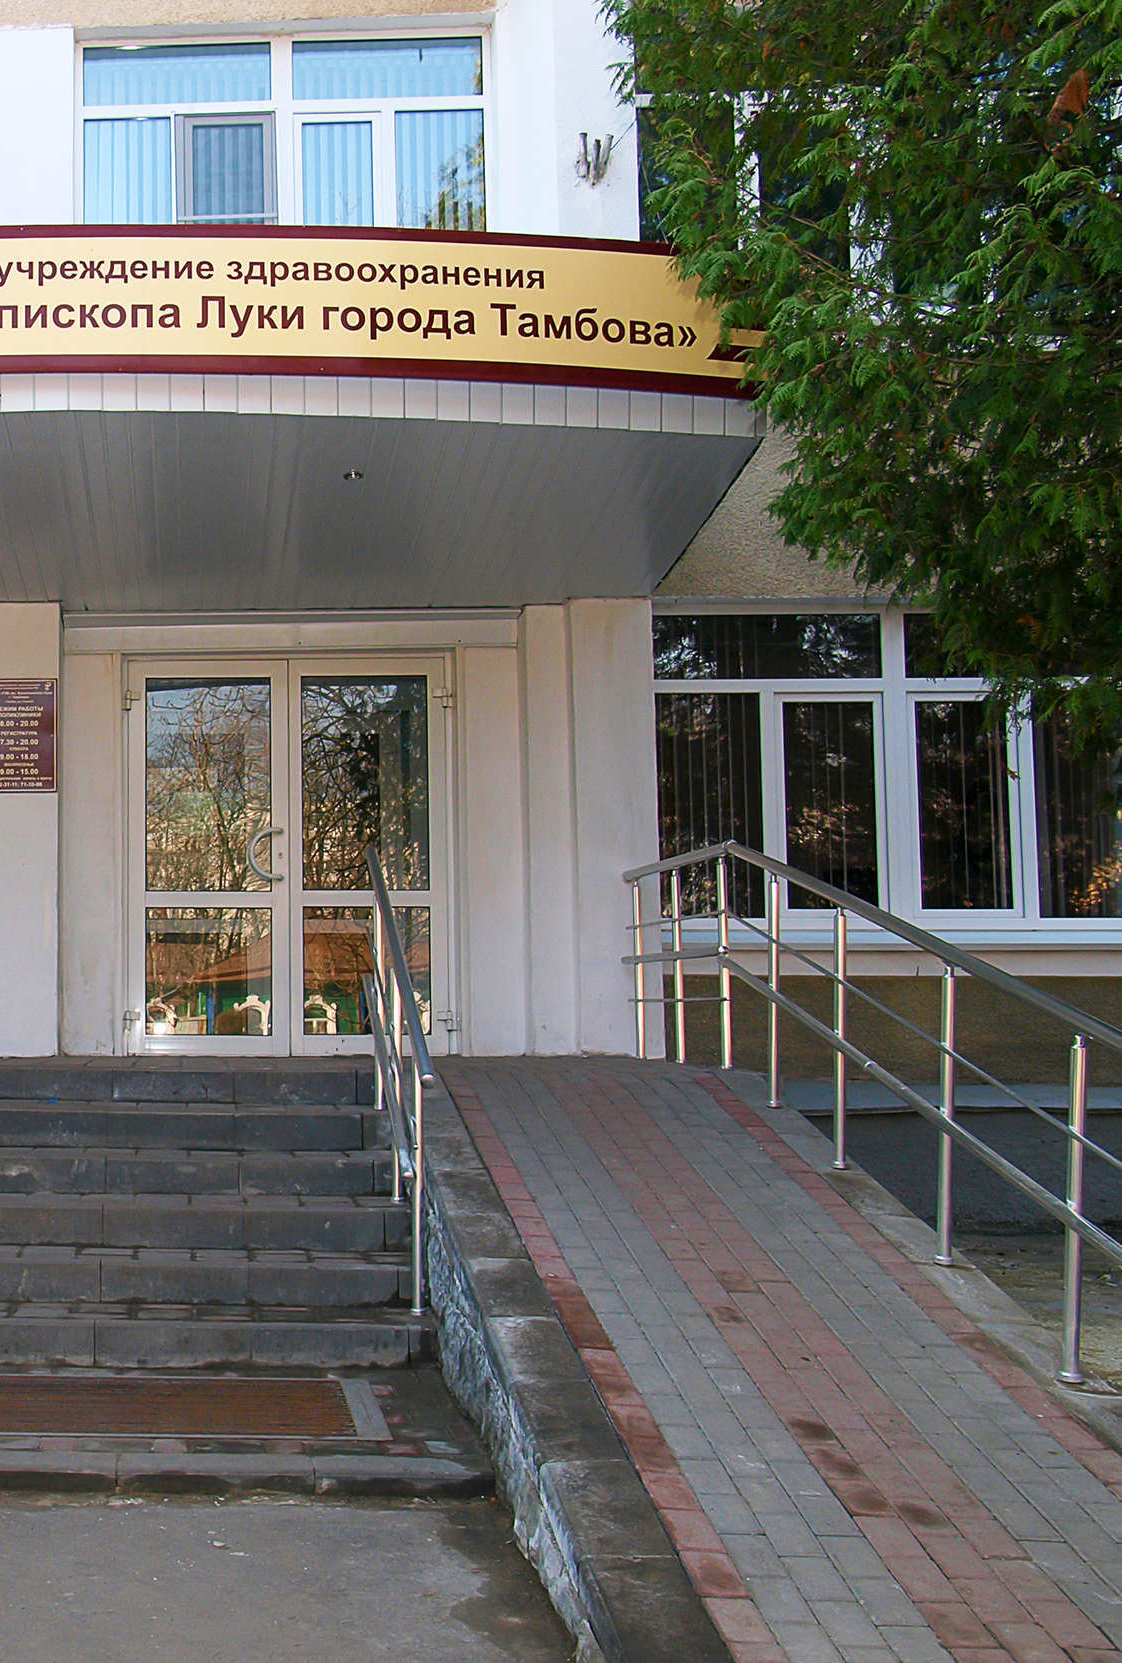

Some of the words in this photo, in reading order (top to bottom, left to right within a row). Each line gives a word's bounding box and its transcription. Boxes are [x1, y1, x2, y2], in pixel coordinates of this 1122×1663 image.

[227, 260, 545, 290] здравоохранения
[196, 295, 305, 338] Луки
[323, 304, 476, 341] города
[490, 302, 698, 349] Тамбова»
